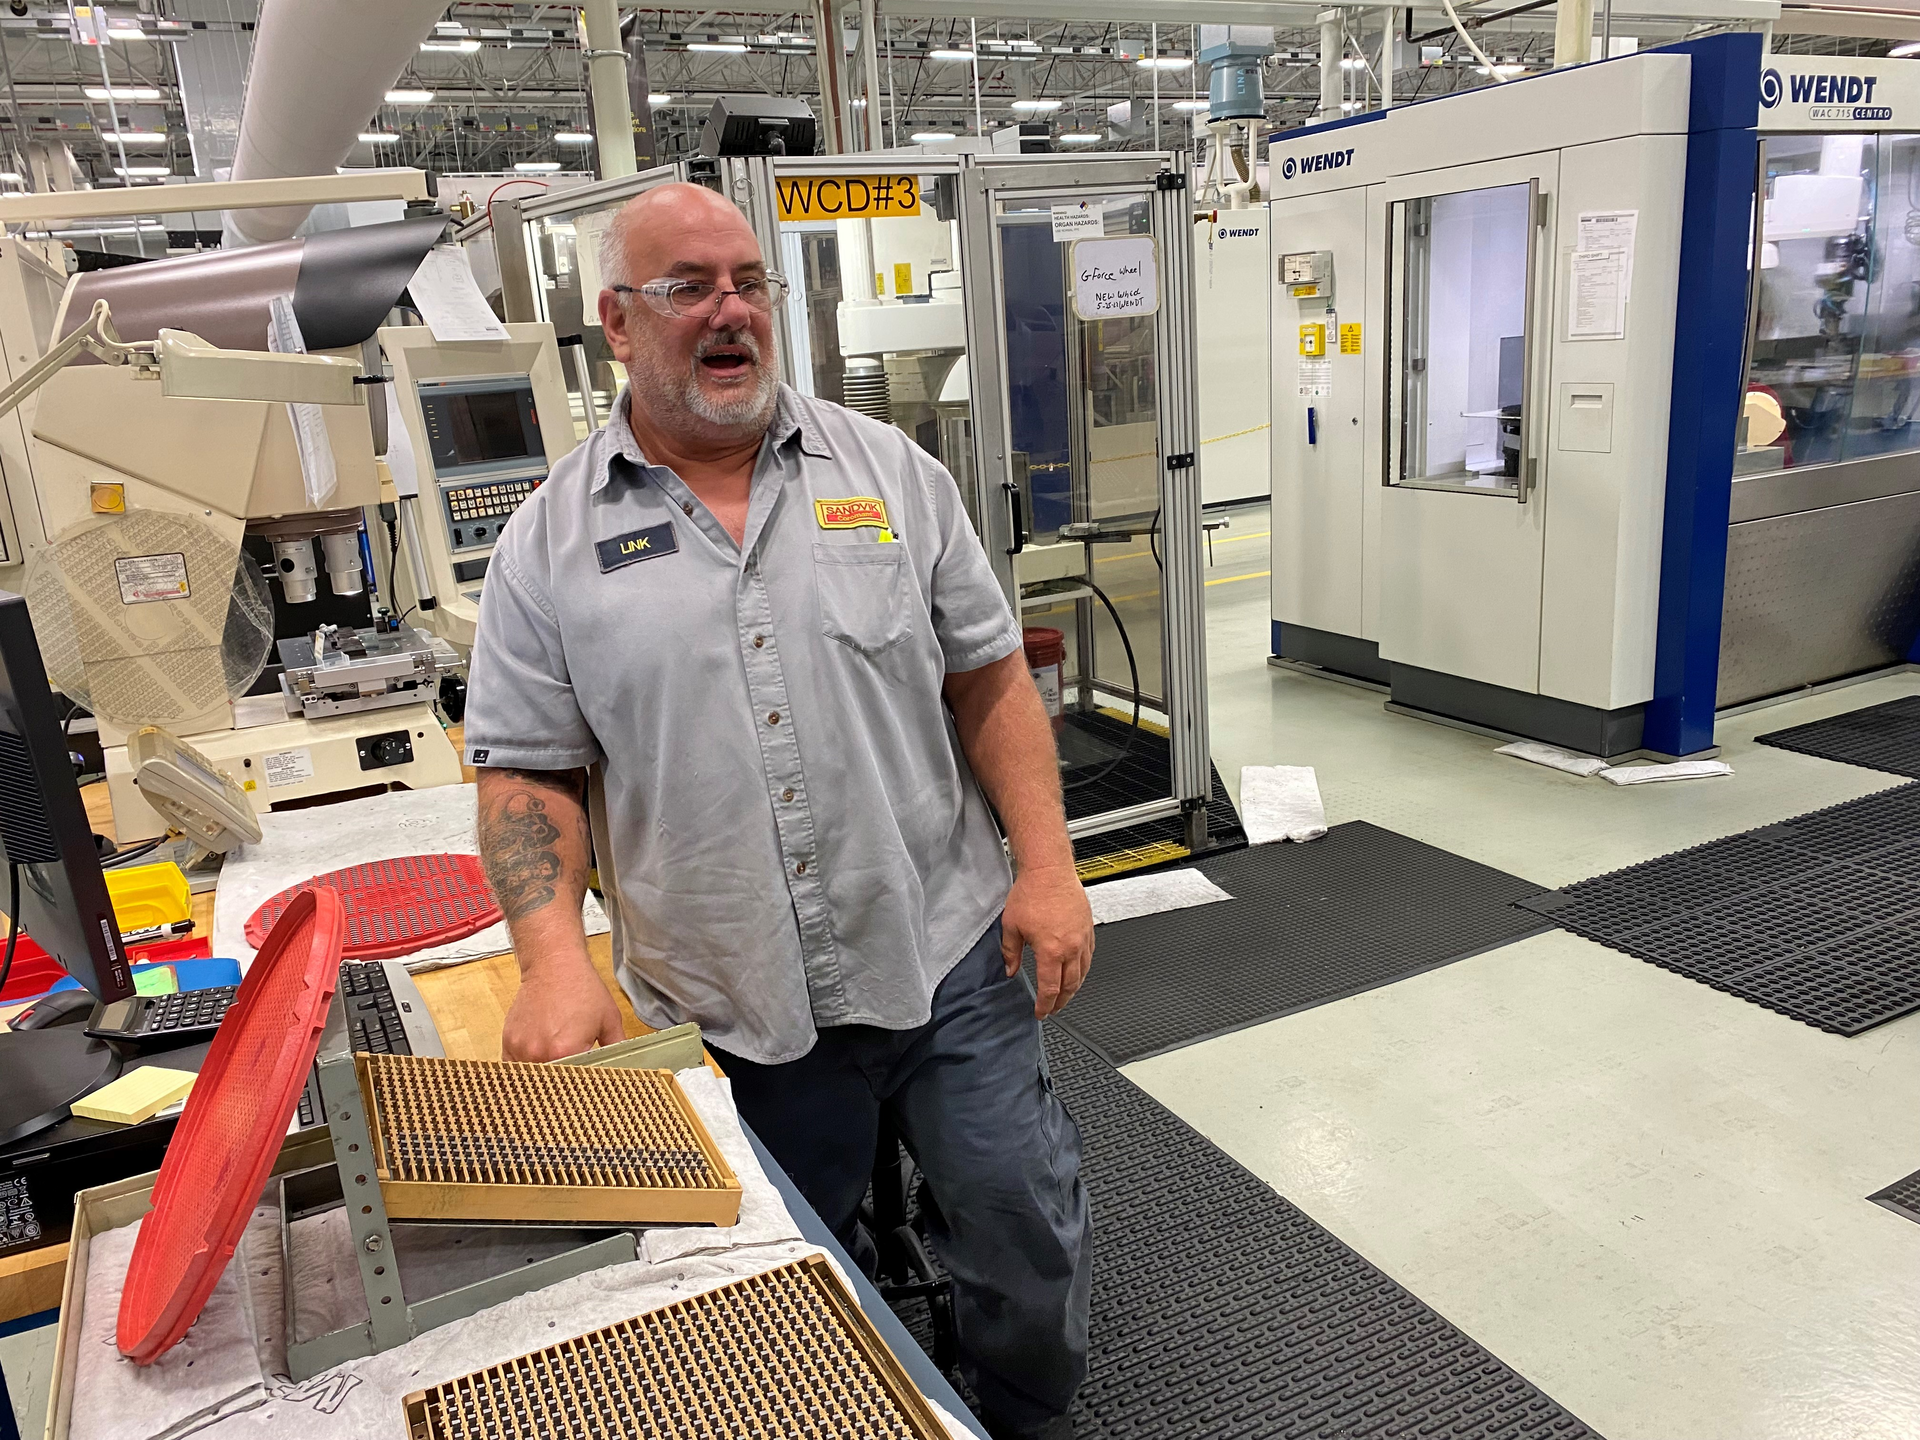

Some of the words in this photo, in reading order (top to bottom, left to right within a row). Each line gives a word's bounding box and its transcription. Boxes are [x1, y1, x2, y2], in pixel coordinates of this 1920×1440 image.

[1790, 74, 1878, 104] WENDT
[1812, 108, 1832, 118] WAC
[1835, 108, 1851, 118] 715
[1855, 109, 1890, 118] CENTRO
[1300, 147, 1355, 175] WENDT
[775, 176, 916, 215] WCD#3
[1229, 228, 1260, 238] WENDT
[825, 503, 879, 515] SANDVIK
[837, 512, 874, 522] Coromant
[619, 536, 652, 555] LINK
